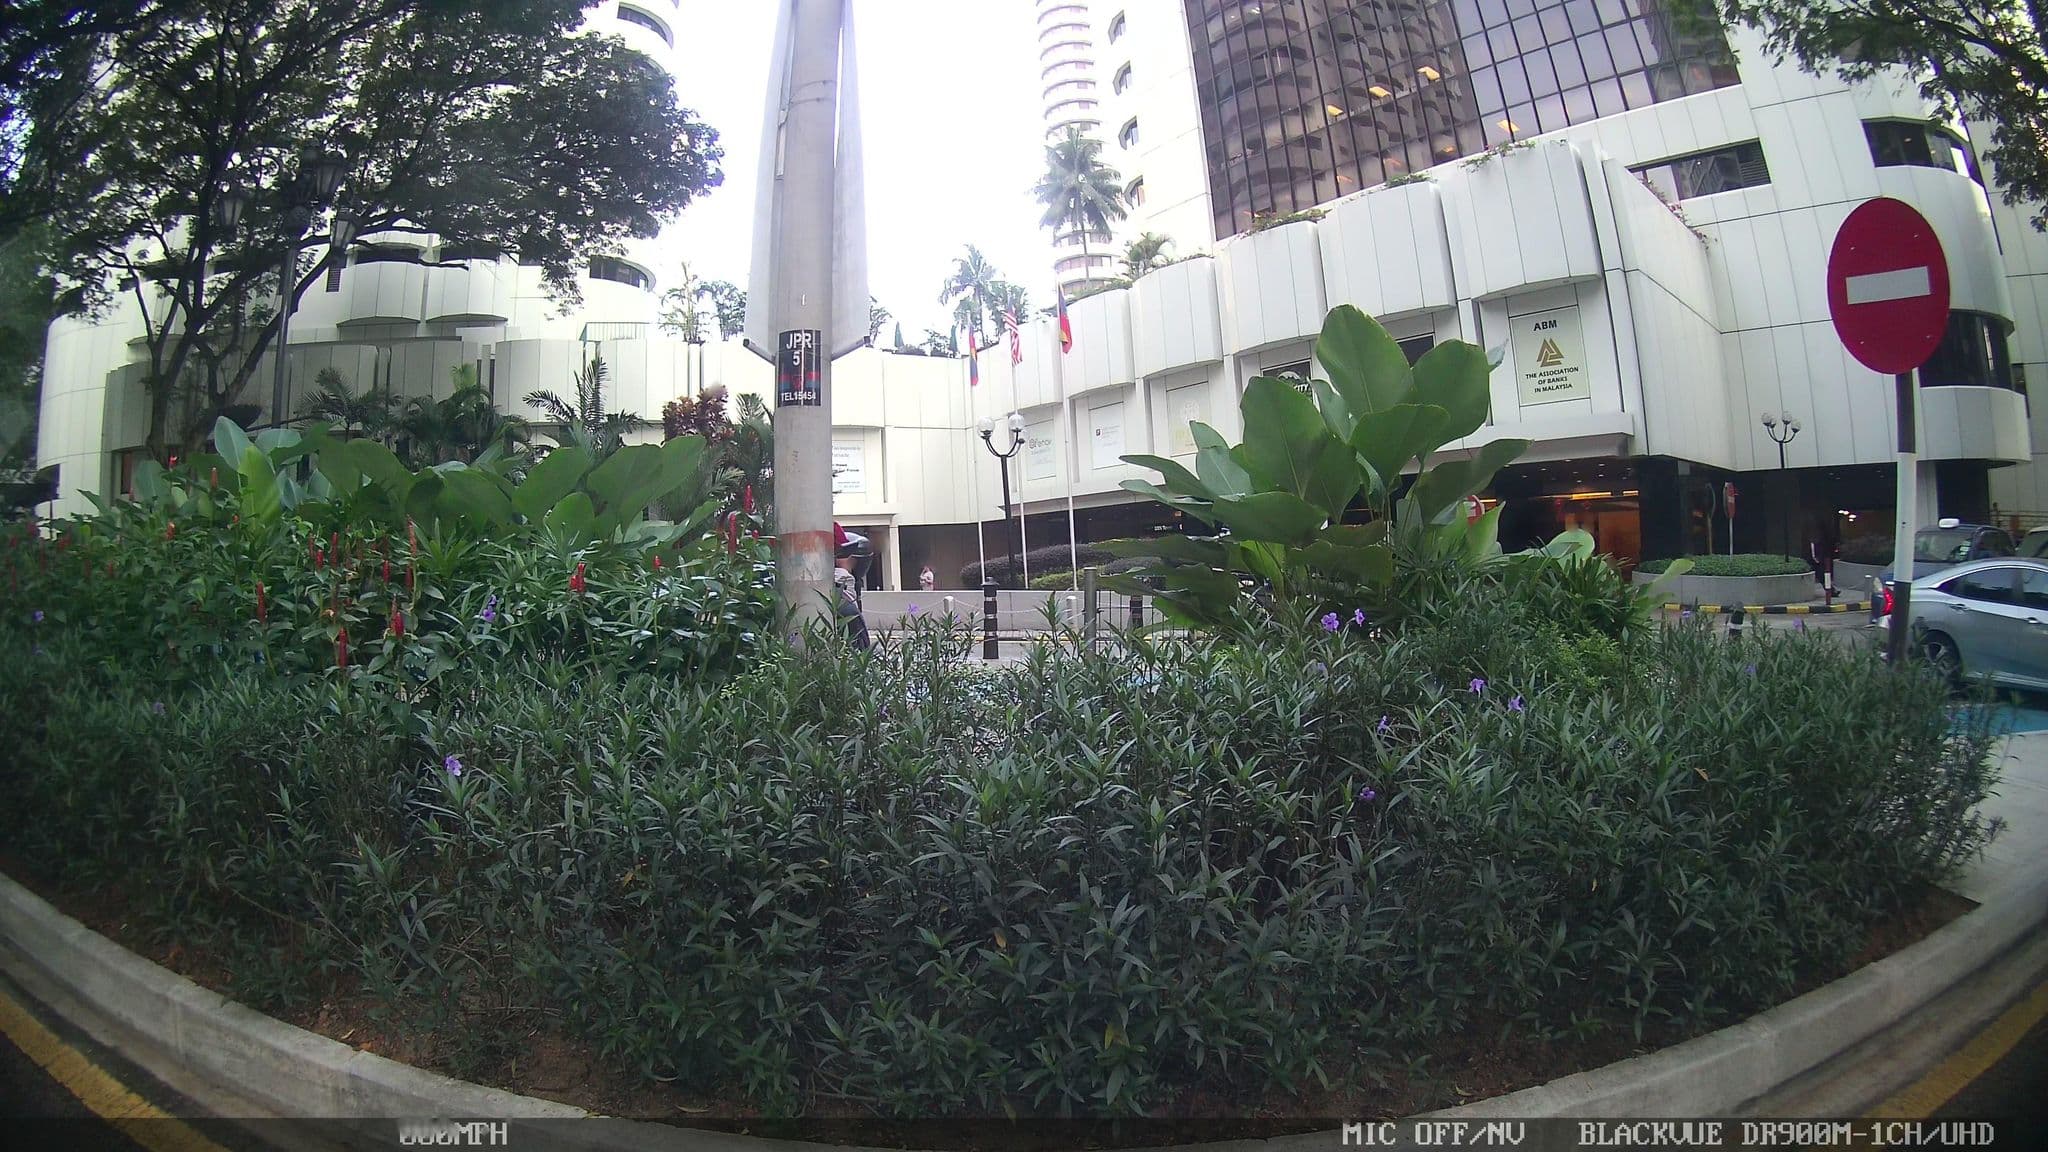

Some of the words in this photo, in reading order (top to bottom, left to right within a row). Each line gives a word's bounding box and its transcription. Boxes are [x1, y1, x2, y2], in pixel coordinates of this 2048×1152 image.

[1534, 320, 1557, 331] ABM
[786, 333, 812, 349] JPR
[793, 350, 800, 366] 5
[1538, 367, 1579, 377] ASSOCIATION
[1542, 384, 1572, 392] MALAYSIA
